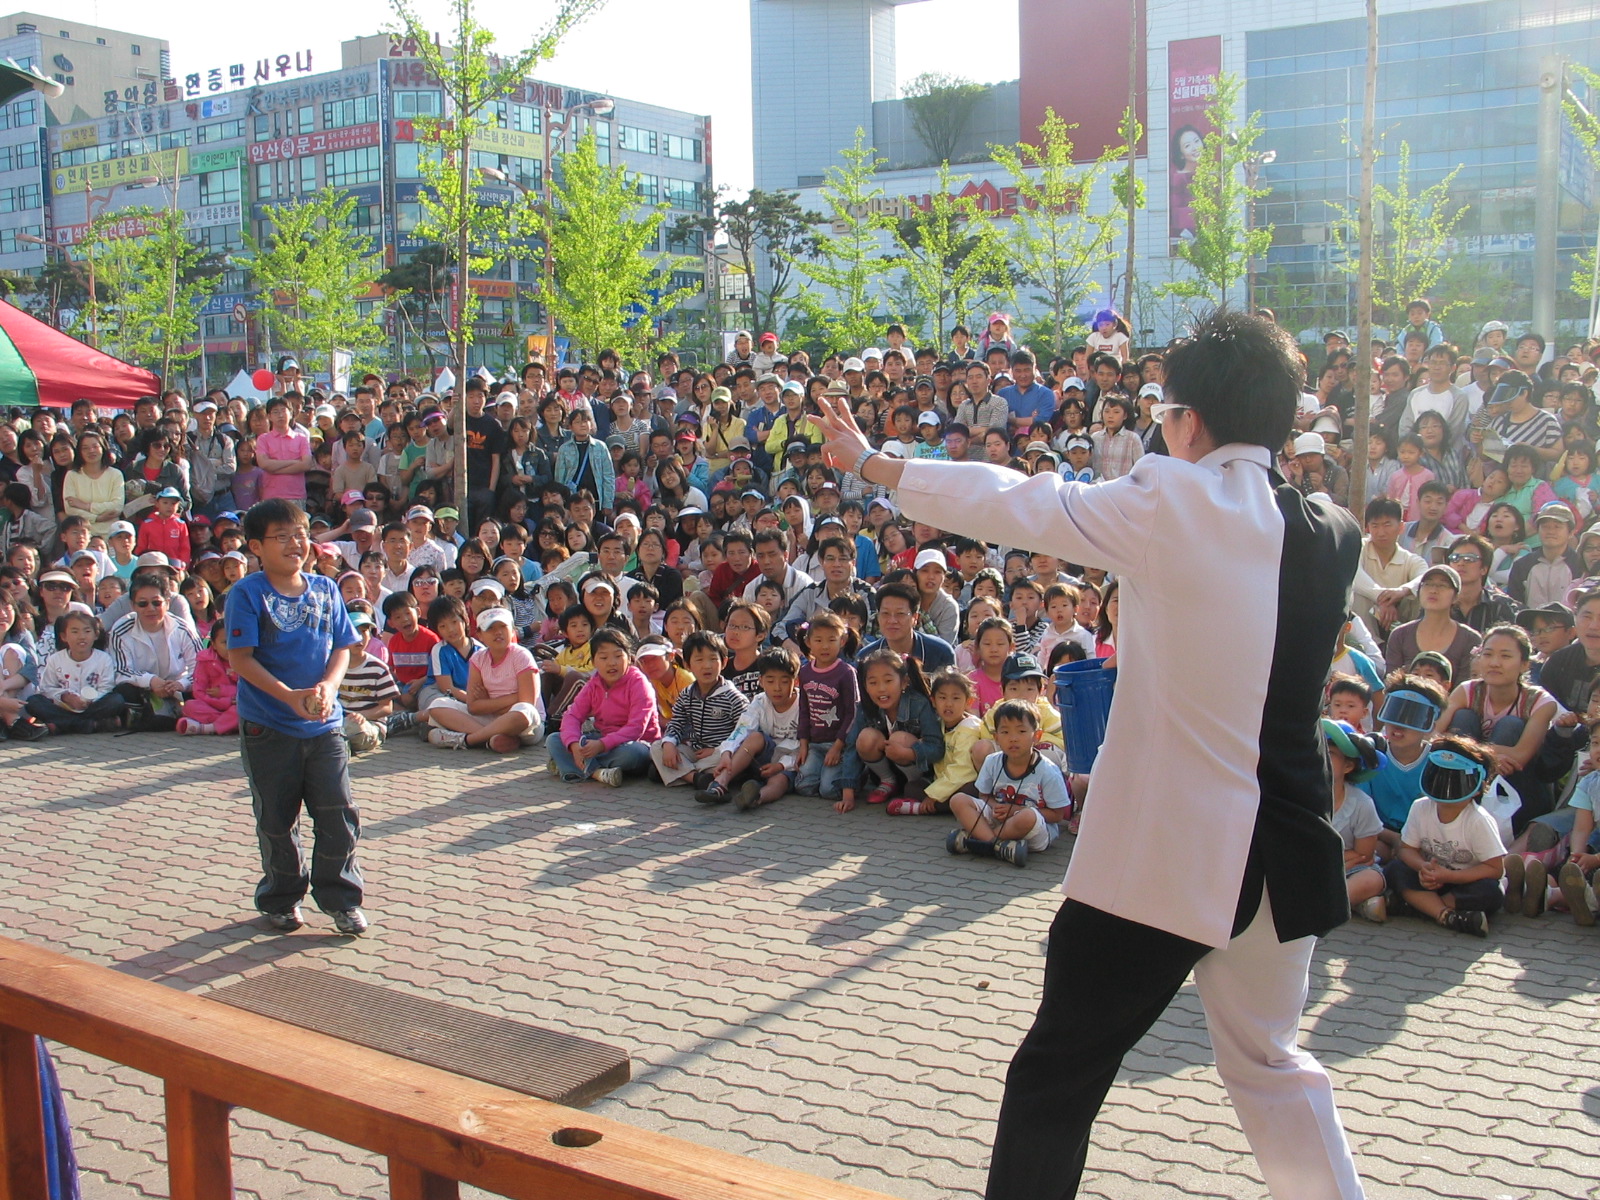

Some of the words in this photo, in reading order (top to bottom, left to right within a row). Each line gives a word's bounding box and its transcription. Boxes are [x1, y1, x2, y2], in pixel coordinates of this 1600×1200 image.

[254, 49, 312, 81] 사우나
[263, 71, 370, 111] 한국투자저축은행
[107, 109, 170, 138] 교보증권
[502, 133, 525, 147] 정신과
[68, 163, 111, 184] 연세드림
[116, 157, 150, 177] 정신과
